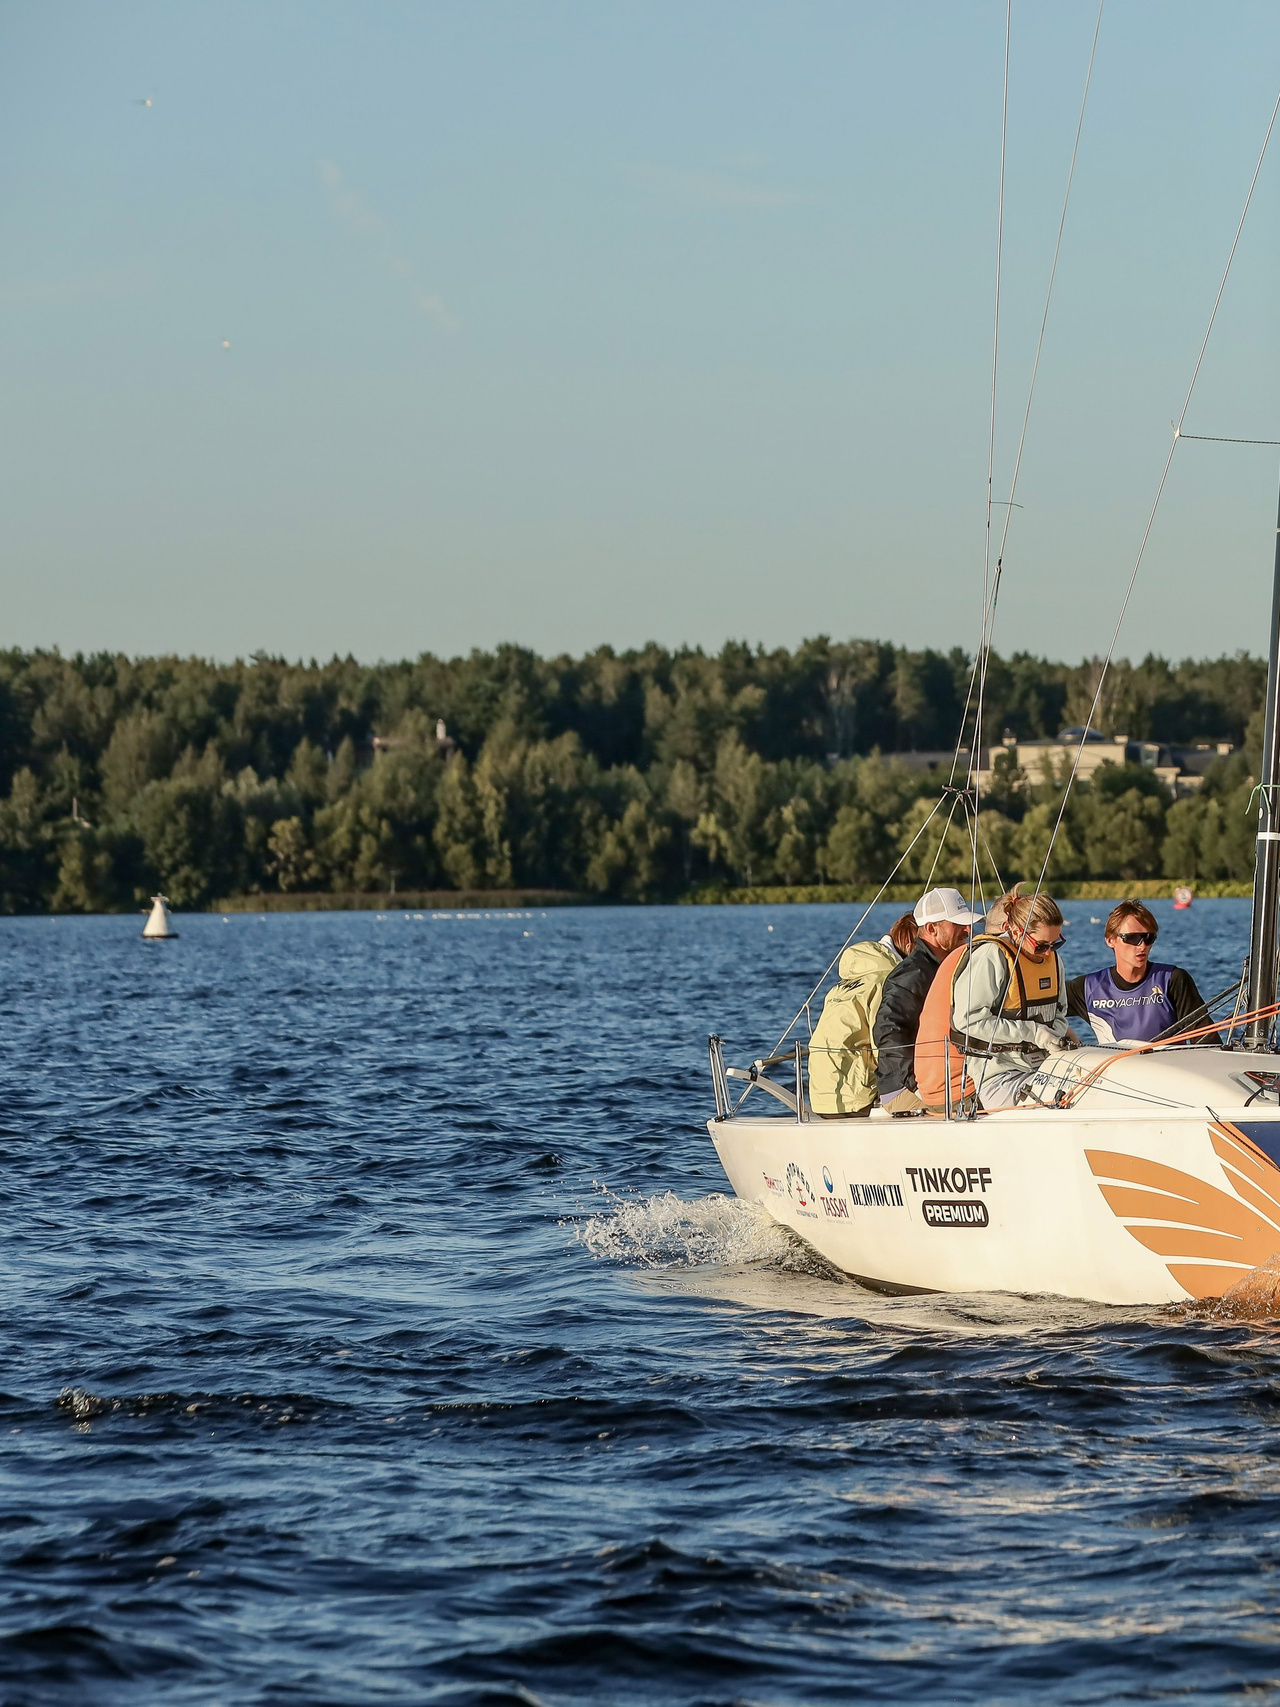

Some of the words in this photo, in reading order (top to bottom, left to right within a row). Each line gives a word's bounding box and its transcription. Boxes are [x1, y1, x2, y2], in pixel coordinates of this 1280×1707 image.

[1093, 994, 1164, 1009] PROYACHTING
[905, 1167, 993, 1193] TINKOFF
[849, 1183, 904, 1207] ВЕДОМОСТИ
[820, 1196, 850, 1218] TASSAY
[925, 1205, 985, 1223] PREMIUM
